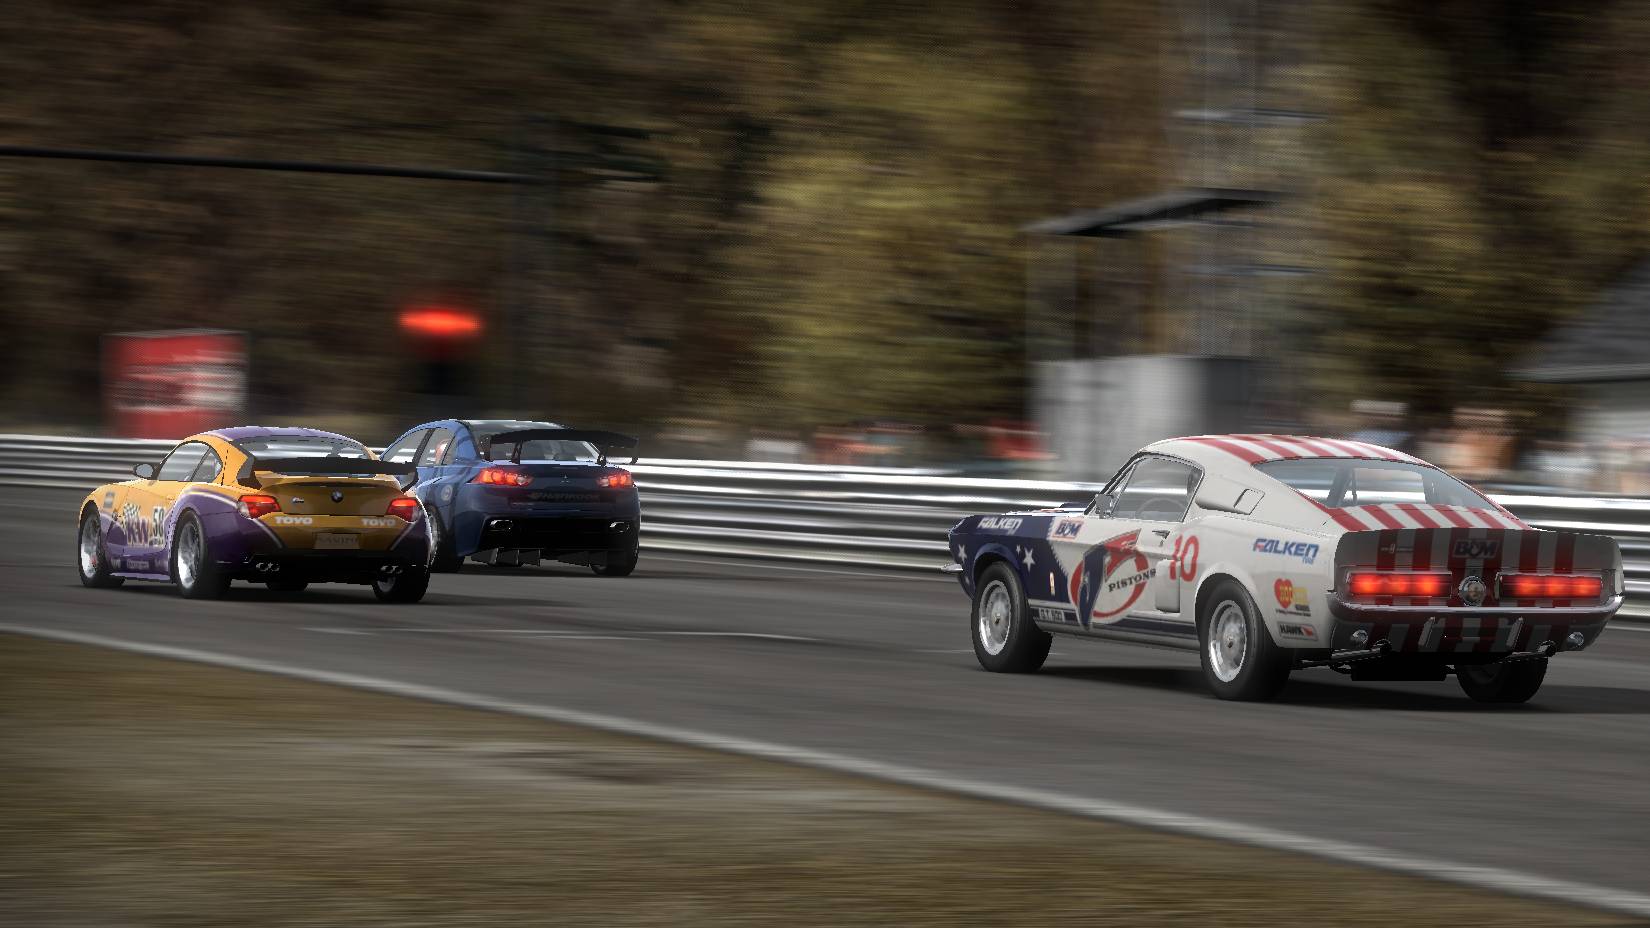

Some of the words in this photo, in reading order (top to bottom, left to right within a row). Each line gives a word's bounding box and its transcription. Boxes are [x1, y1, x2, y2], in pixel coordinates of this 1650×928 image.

[274, 516, 313, 526] TOYO
[361, 517, 396, 527] TOYO
[976, 517, 1023, 530] FALKEN
[1252, 538, 1320, 559] FALKEN
[1169, 534, 1200, 582] 10
[1108, 568, 1157, 592] PISTONS
